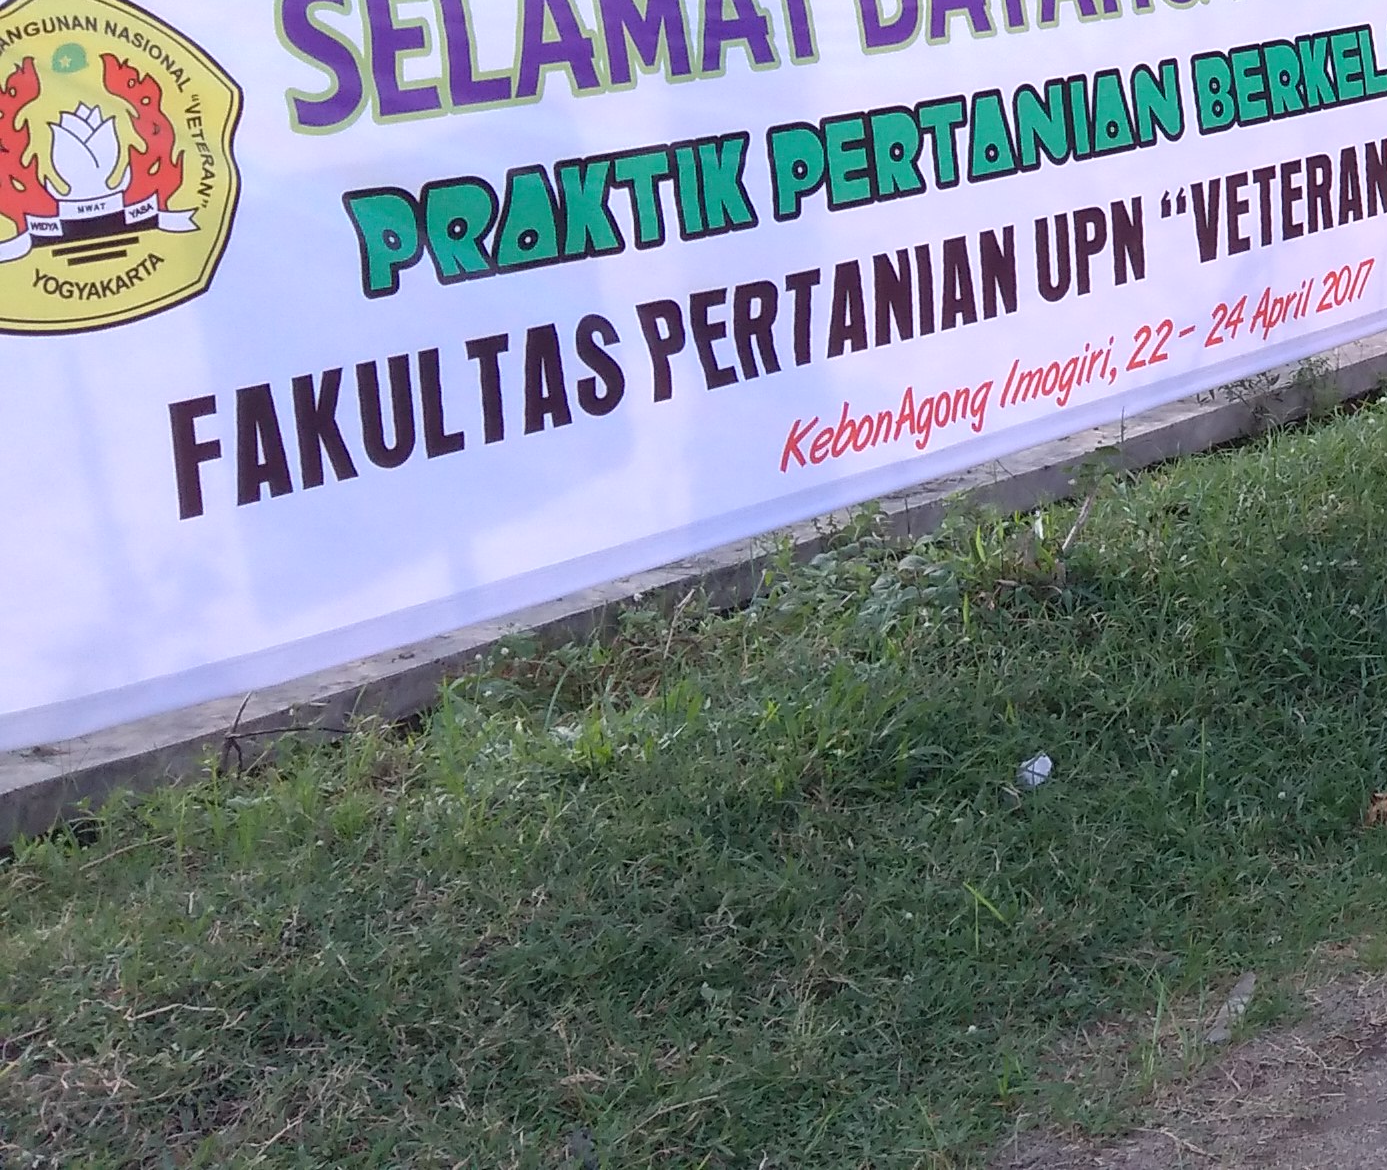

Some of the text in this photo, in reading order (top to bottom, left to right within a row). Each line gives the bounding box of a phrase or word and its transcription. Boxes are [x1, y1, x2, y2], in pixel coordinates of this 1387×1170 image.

[0, 15, 97, 56] ANGUNAN
[104, 20, 191, 93] NASIONAL
[30, 221, 59, 232] WIDYA
[129, 203, 154, 219] YASA
[343, 132, 758, 299] PRAKTIK
[767, 58, 1185, 221] PERTANIAN
[32, 252, 165, 301] YOGYAKARTA
[169, 315, 625, 519] FAKULTAS
[635, 225, 1017, 403] PERTANIAN
[1035, 196, 1145, 302] UPN
[780, 381, 993, 472] KebonAgong
[1000, 336, 1117, 407] Imogiri,
[1204, 295, 1247, 347] 24
[1250, 281, 1313, 340] April
[1316, 258, 1375, 314] 2017
